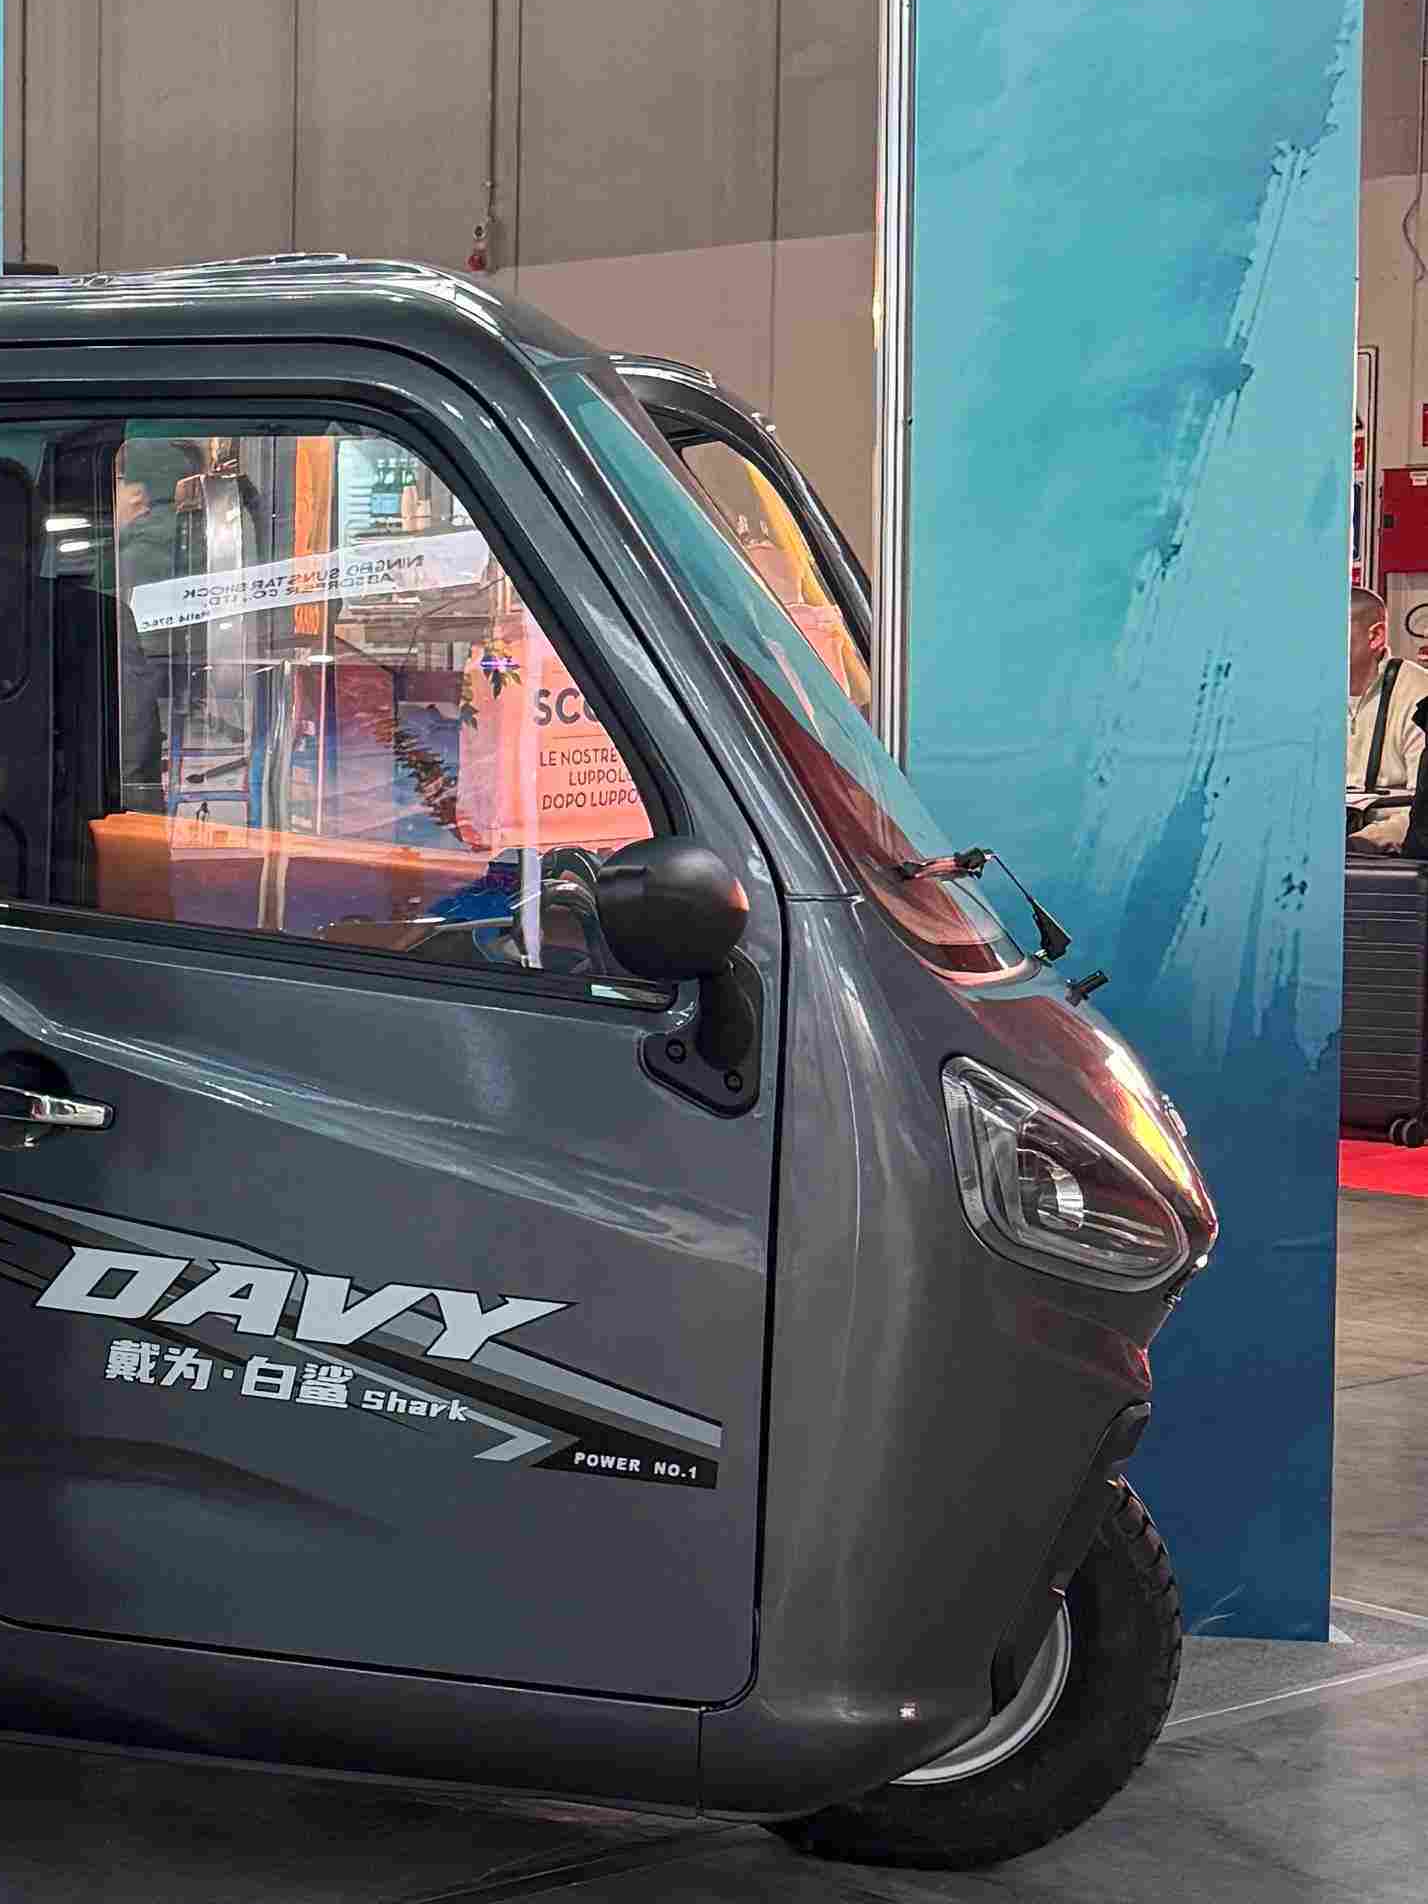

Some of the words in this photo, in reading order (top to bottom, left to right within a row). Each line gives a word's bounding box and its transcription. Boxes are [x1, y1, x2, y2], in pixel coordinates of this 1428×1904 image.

[540, 751, 557, 767] LE
[561, 748, 617, 765] NOSTRE
[542, 792, 586, 810] DOPO
[34, 1243, 579, 1361] DAVY
[362, 1389, 469, 1424] Shark
[574, 1450, 641, 1474] POWER
[654, 1460, 698, 1481] NO.1
